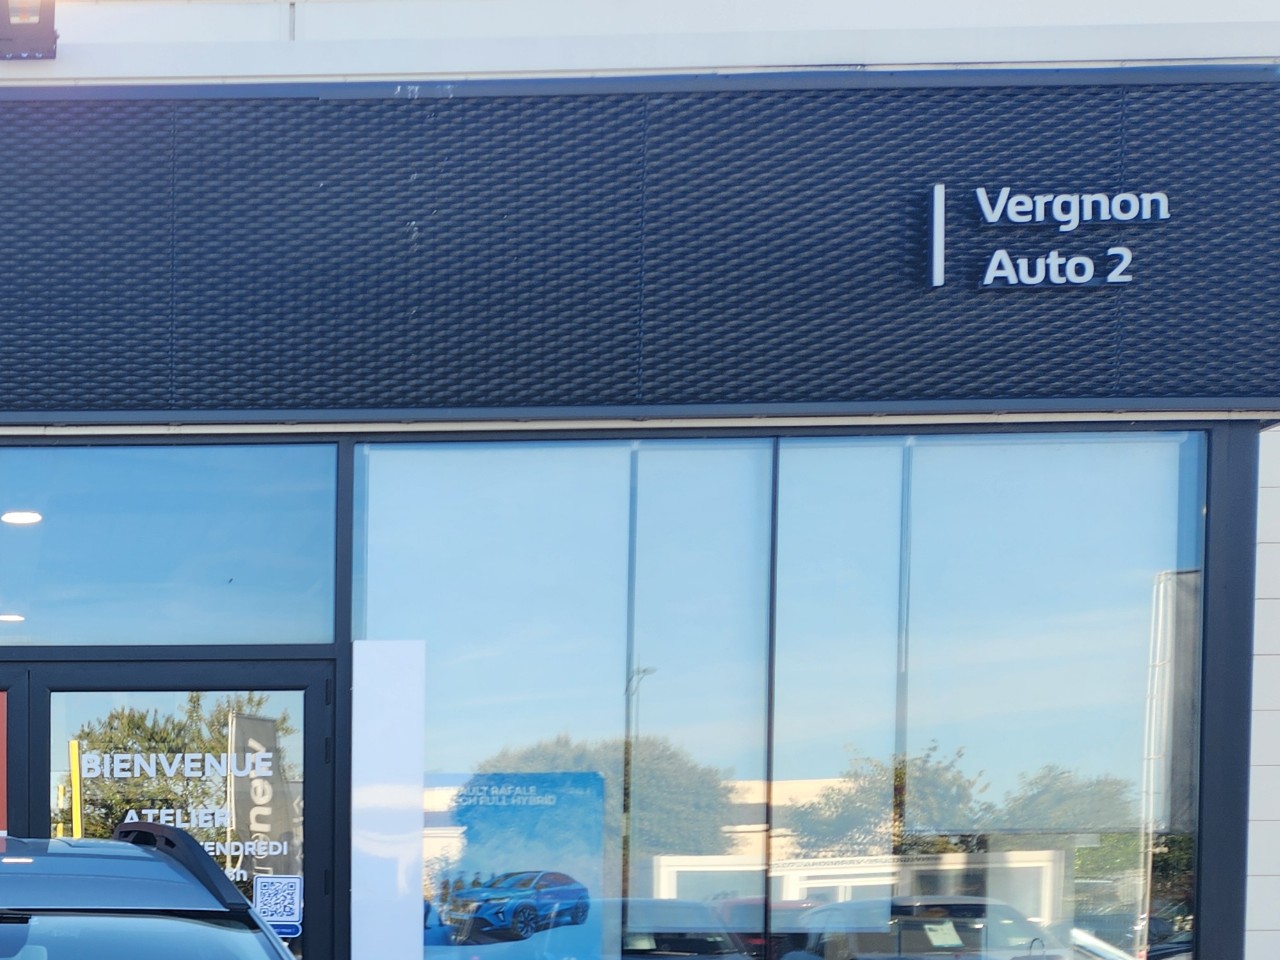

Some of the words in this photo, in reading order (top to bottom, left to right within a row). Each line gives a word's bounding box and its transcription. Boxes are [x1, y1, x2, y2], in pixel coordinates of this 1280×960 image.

[976, 186, 1171, 232] Vergnon
[982, 247, 1095, 286] Auto
[1106, 246, 1134, 284] 2
[81, 752, 274, 778] BIENVENUE
[124, 808, 231, 828] ATELIER
[200, 841, 289, 857] ENDREDI
